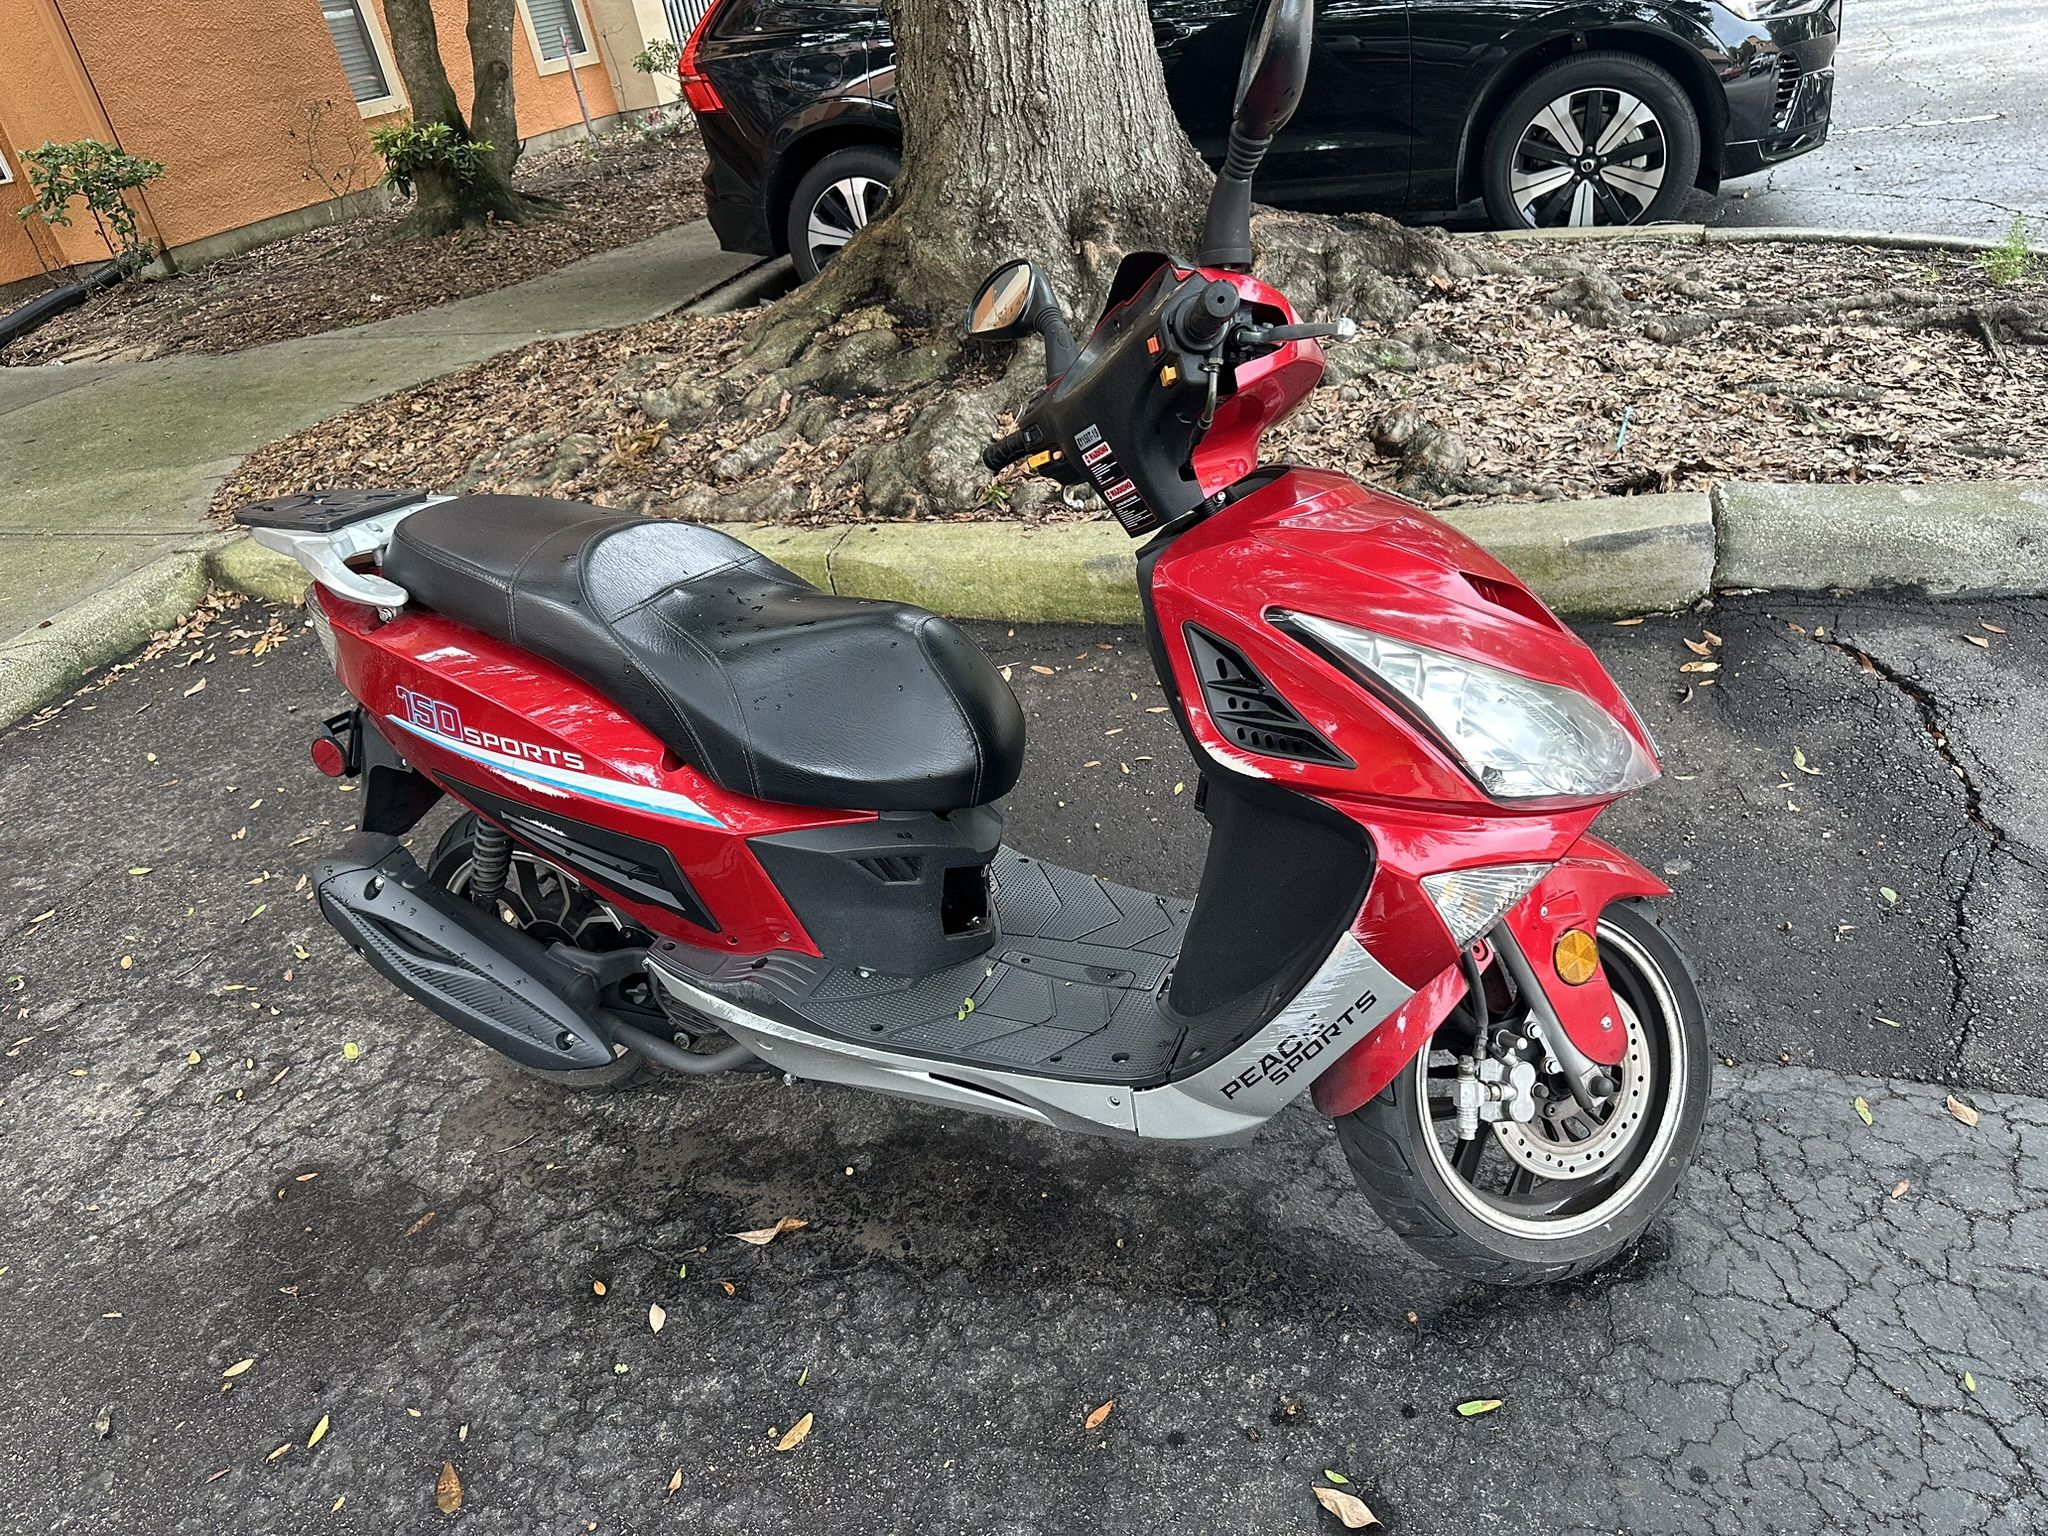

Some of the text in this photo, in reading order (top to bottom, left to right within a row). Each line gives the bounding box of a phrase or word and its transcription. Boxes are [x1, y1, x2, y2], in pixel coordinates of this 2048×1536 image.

[395, 685, 585, 771] 150 SPORTS
[1219, 1013, 1326, 1101] PEAC
[1268, 989, 1378, 1086] SPORTS
